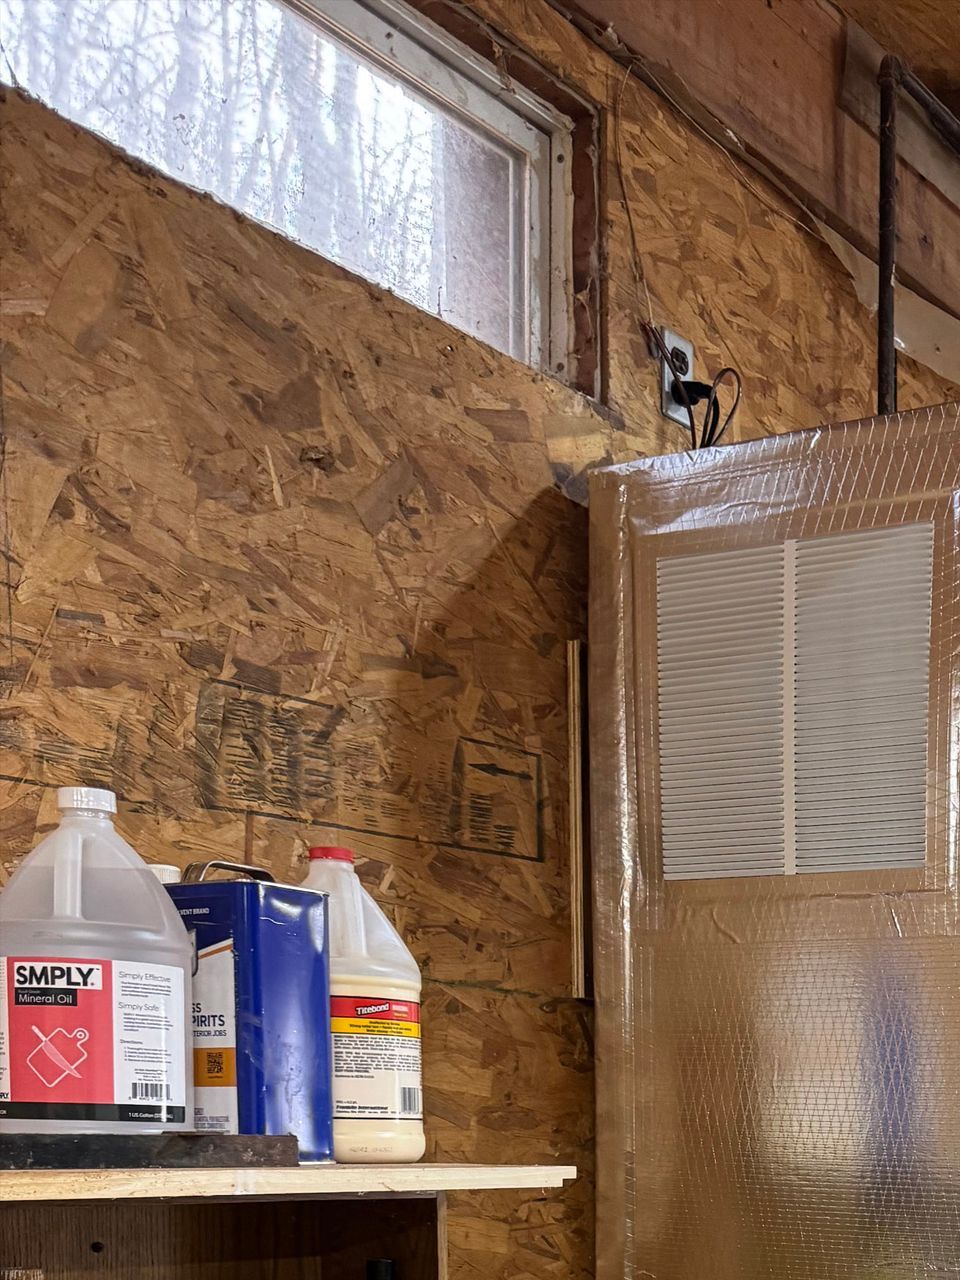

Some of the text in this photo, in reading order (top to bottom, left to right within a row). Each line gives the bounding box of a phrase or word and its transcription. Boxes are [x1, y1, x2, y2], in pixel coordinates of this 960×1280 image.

[16, 965, 96, 987] SMPLY
[118, 970, 144, 981] Simply
[18, 993, 73, 1005] Mineral Oil
[118, 1002, 160, 1012] Simply Safe
[355, 1003, 390, 1015] Titebond
